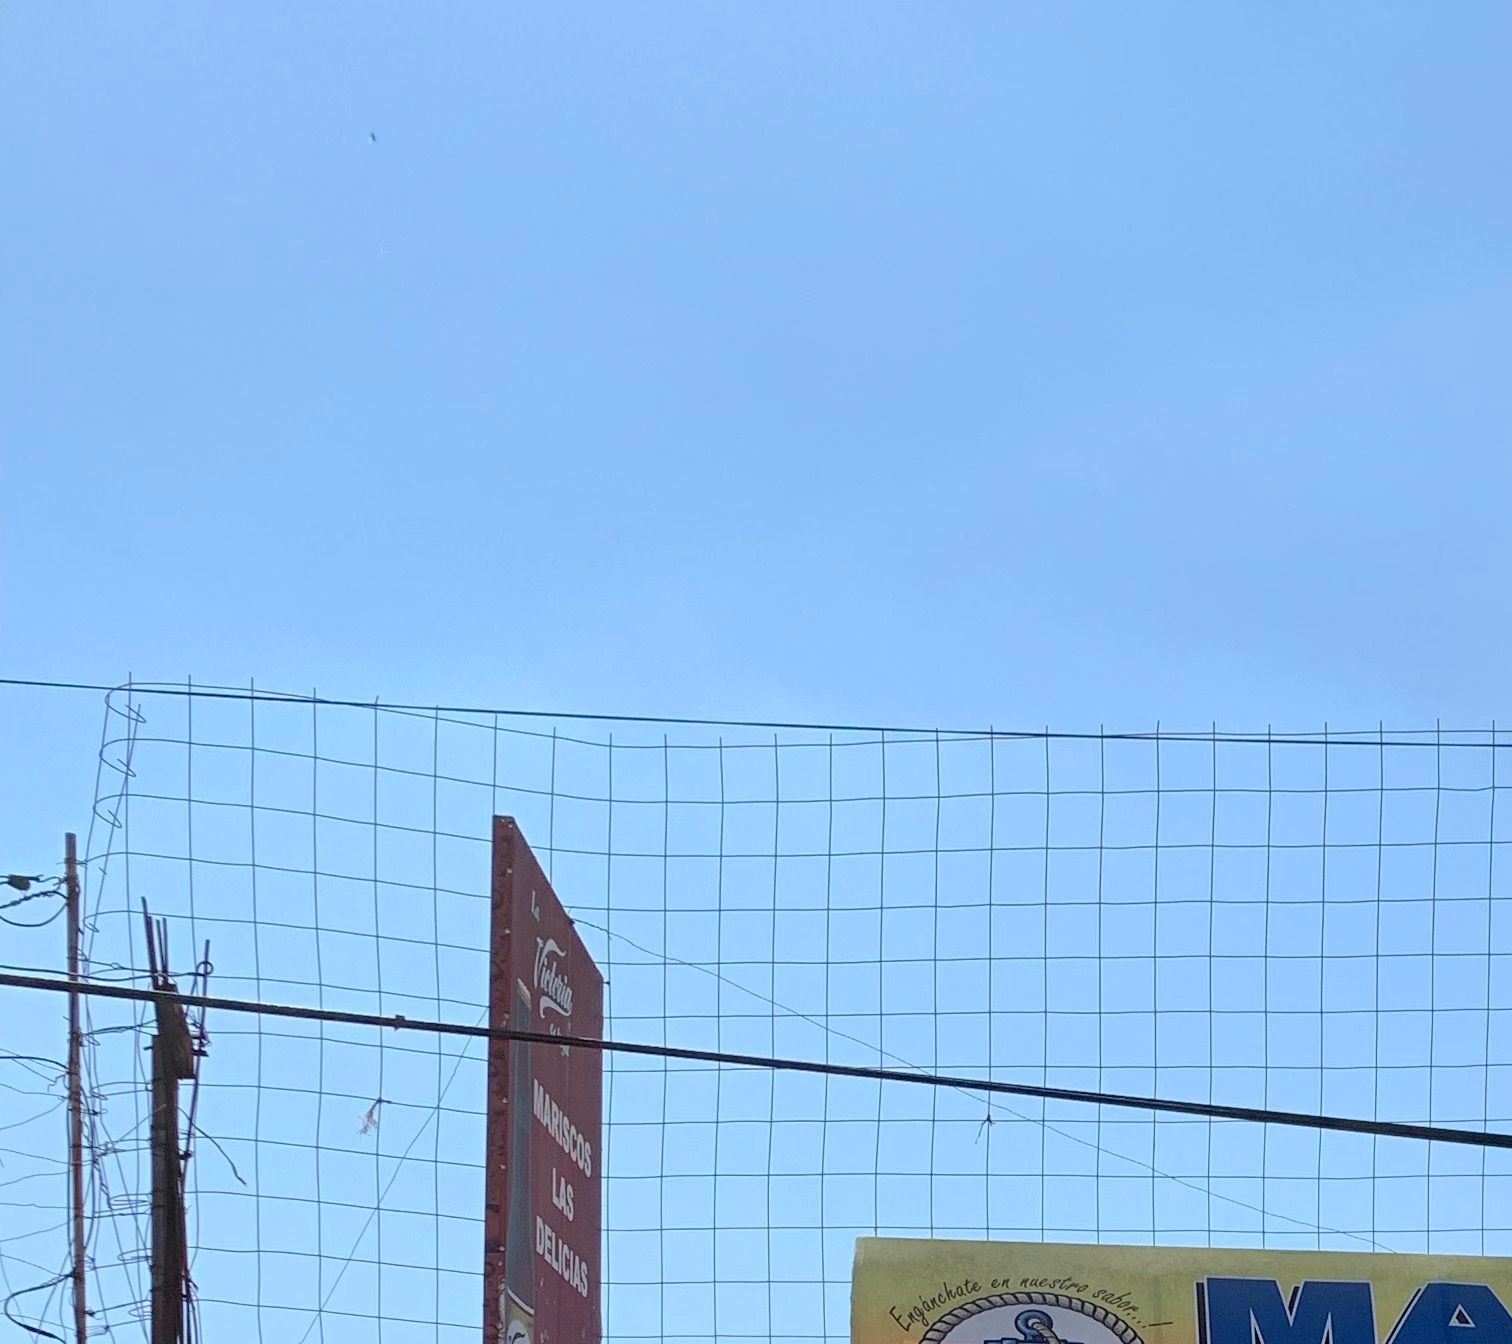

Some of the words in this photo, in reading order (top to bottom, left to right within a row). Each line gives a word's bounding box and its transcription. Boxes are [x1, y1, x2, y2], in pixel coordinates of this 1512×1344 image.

[533, 936, 573, 1017] Victoria
[533, 1078, 592, 1178] MARISCOS
[552, 1167, 575, 1222] LAS
[536, 1215, 589, 1299] DELICIAS
[991, 1277, 1010, 1289] en
[1020, 1277, 1089, 1293] nuestro
